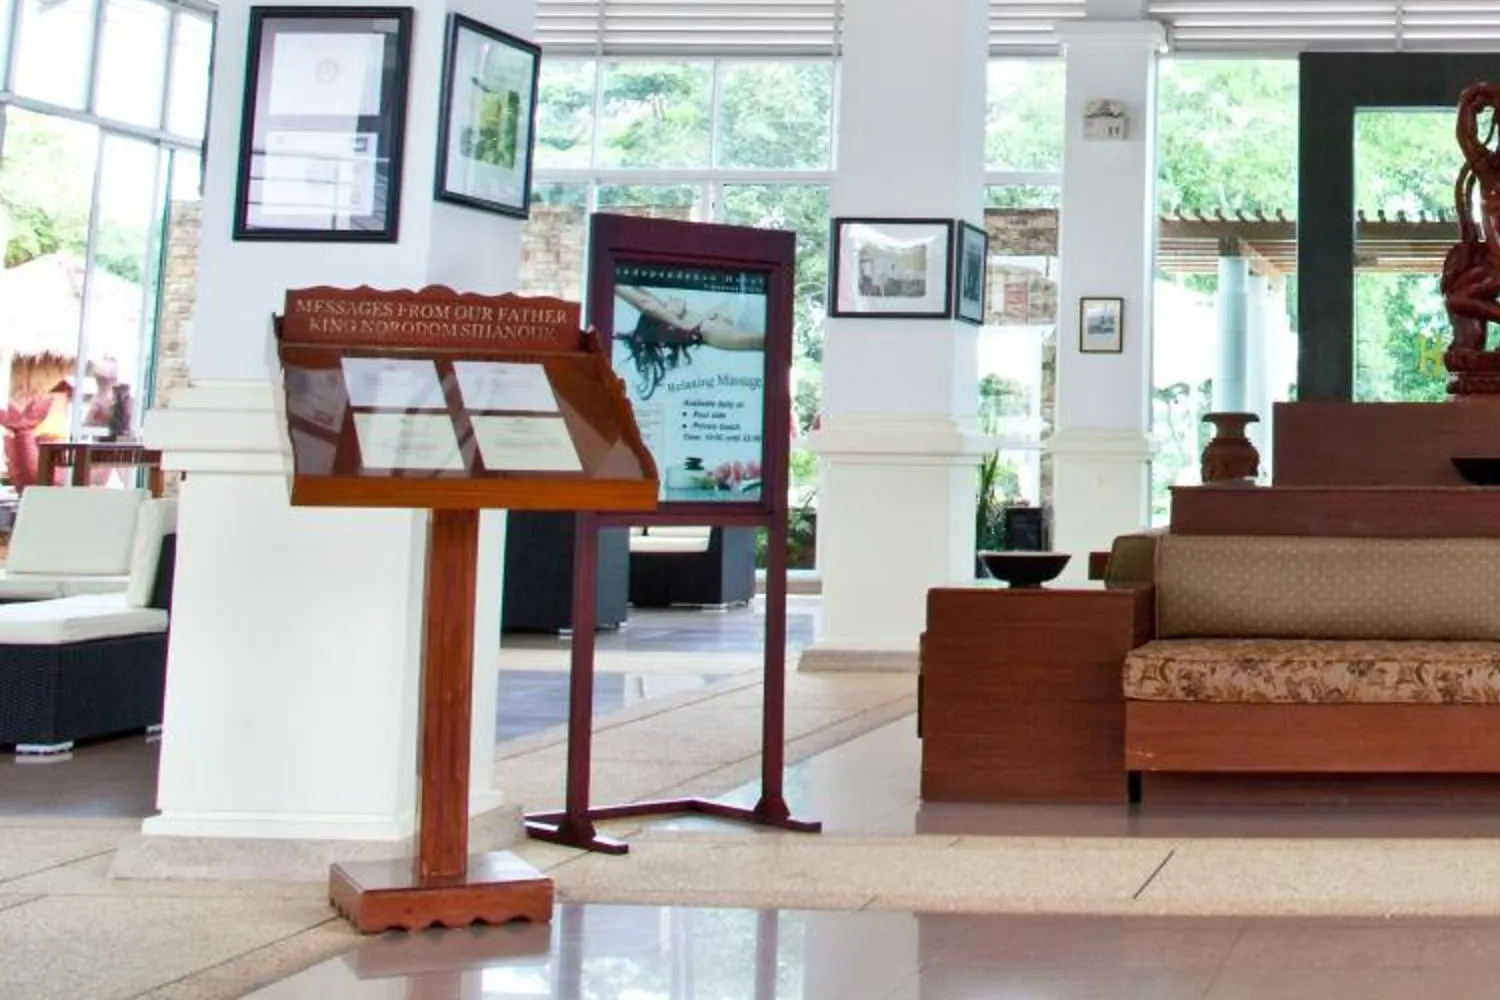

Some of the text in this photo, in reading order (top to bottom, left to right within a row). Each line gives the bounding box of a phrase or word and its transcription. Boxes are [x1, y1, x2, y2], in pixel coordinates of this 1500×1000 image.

[296, 299, 568, 326] MESSAGES FROM OUR FATHER
[309, 316, 556, 342] KING NORODOM SIHANOUK
